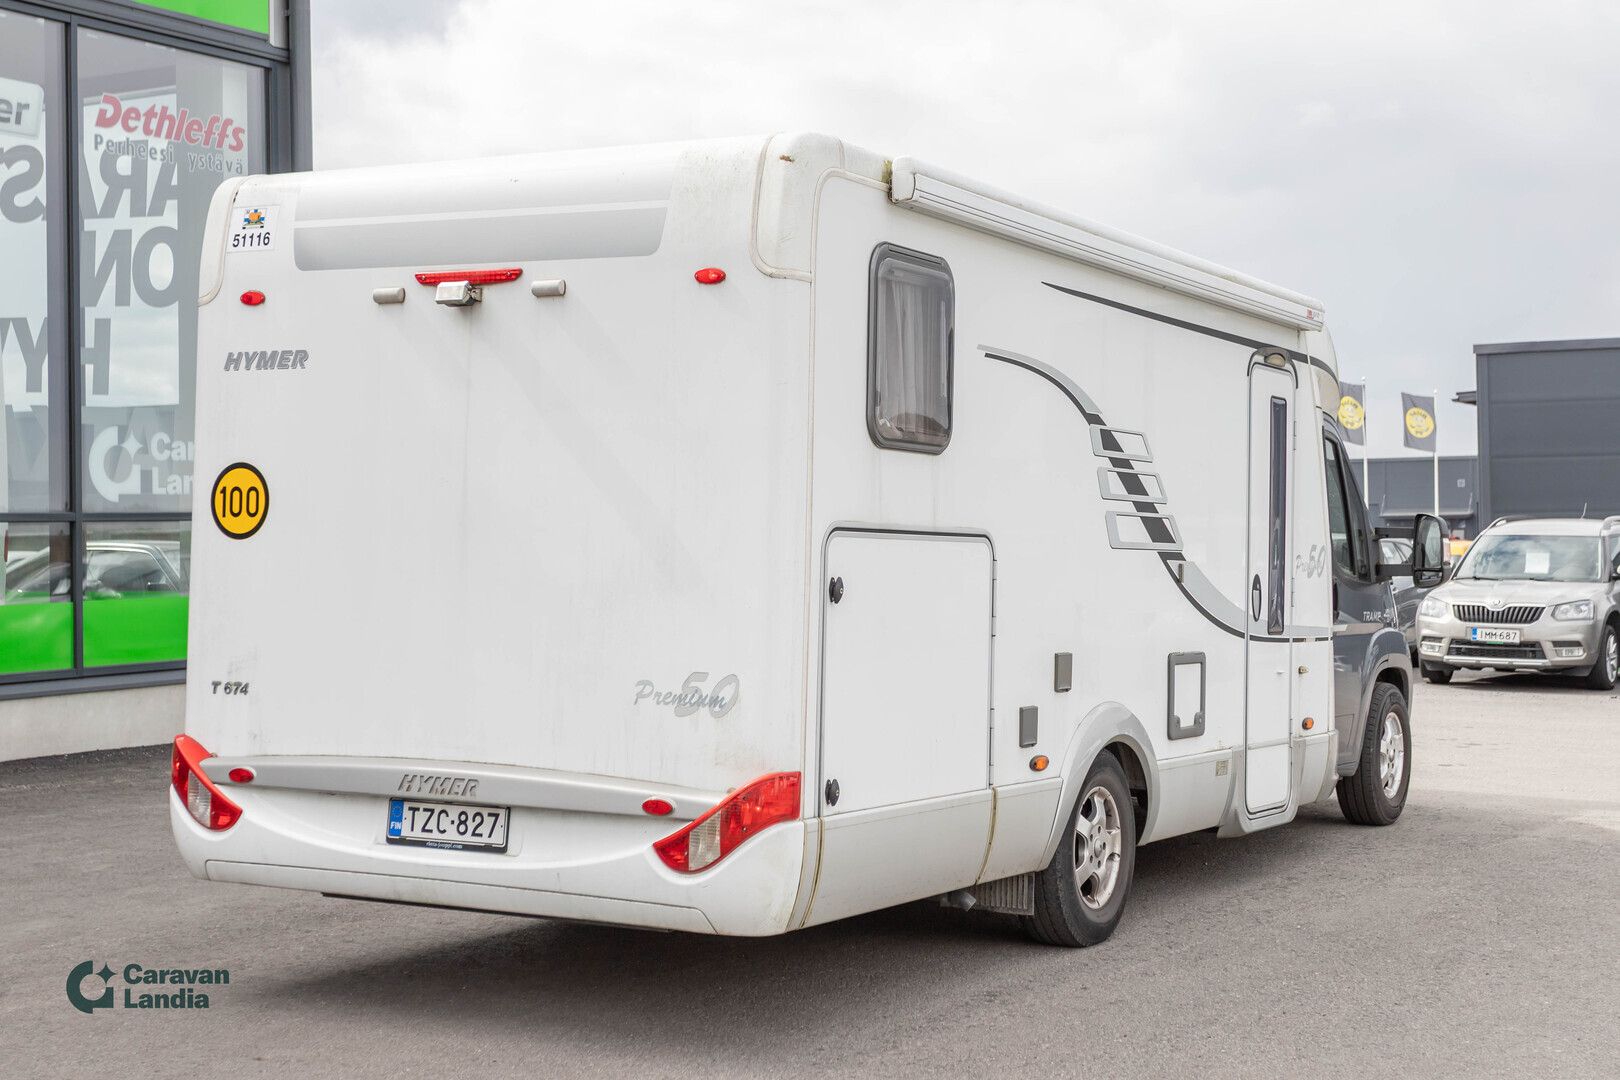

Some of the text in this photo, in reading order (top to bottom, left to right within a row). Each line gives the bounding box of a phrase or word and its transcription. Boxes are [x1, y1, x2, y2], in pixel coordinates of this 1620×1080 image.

[95, 94, 245, 152] Dethleffs
[93, 133, 244, 174] Perheesi ystävä
[232, 232, 270, 247] 51116
[223, 349, 309, 372] HYMER
[218, 486, 260, 518] 100
[211, 680, 250, 696] T 674
[633, 679, 728, 708] Premium
[397, 774, 480, 797] HYMER
[407, 806, 501, 839] TZC-827
